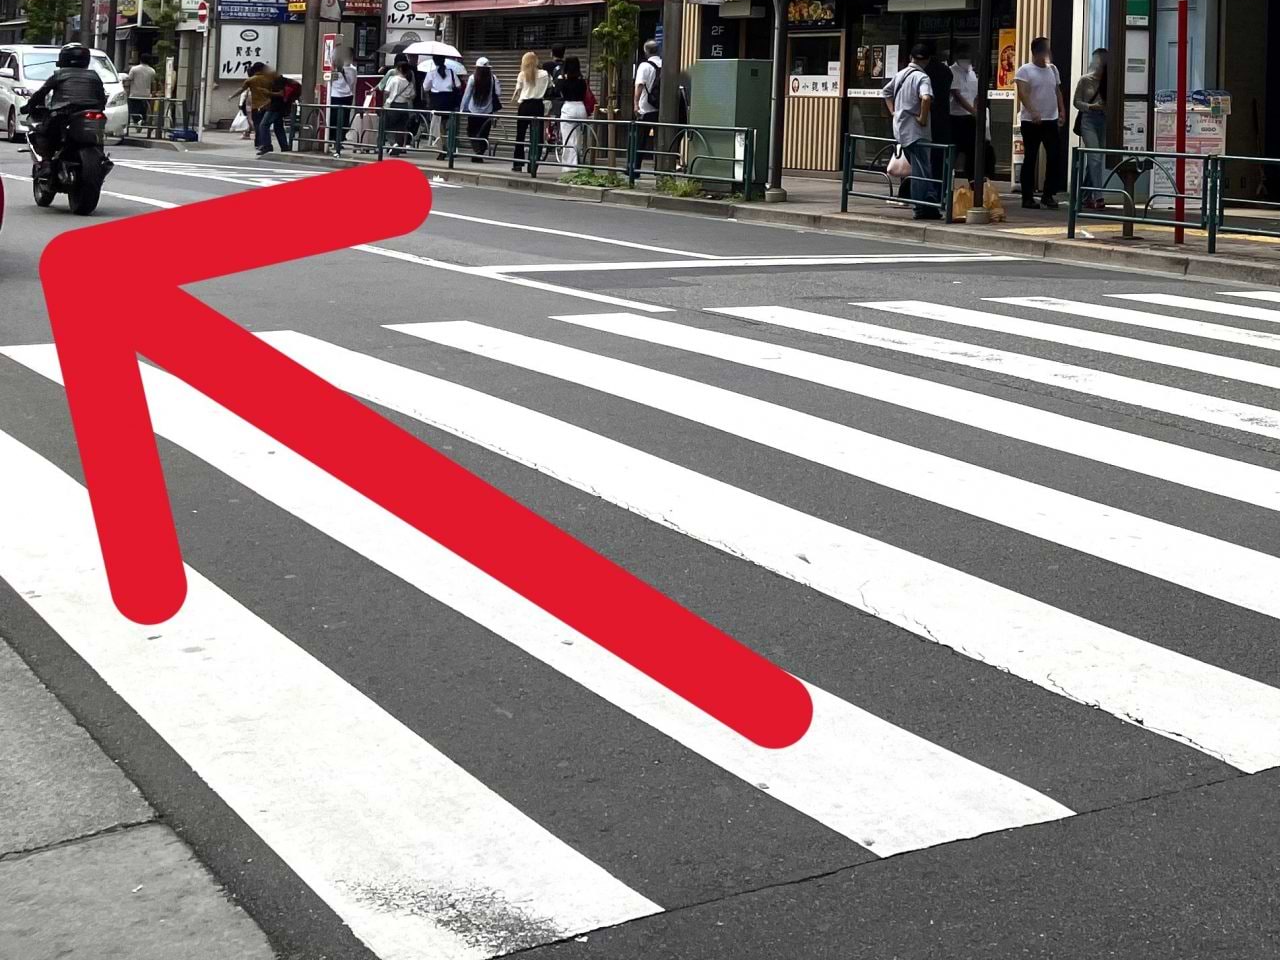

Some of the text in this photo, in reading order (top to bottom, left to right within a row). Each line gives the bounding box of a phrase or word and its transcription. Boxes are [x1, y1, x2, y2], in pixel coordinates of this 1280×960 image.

[387, 13, 426, 24] ルノアー
[712, 26, 725, 35] 2F
